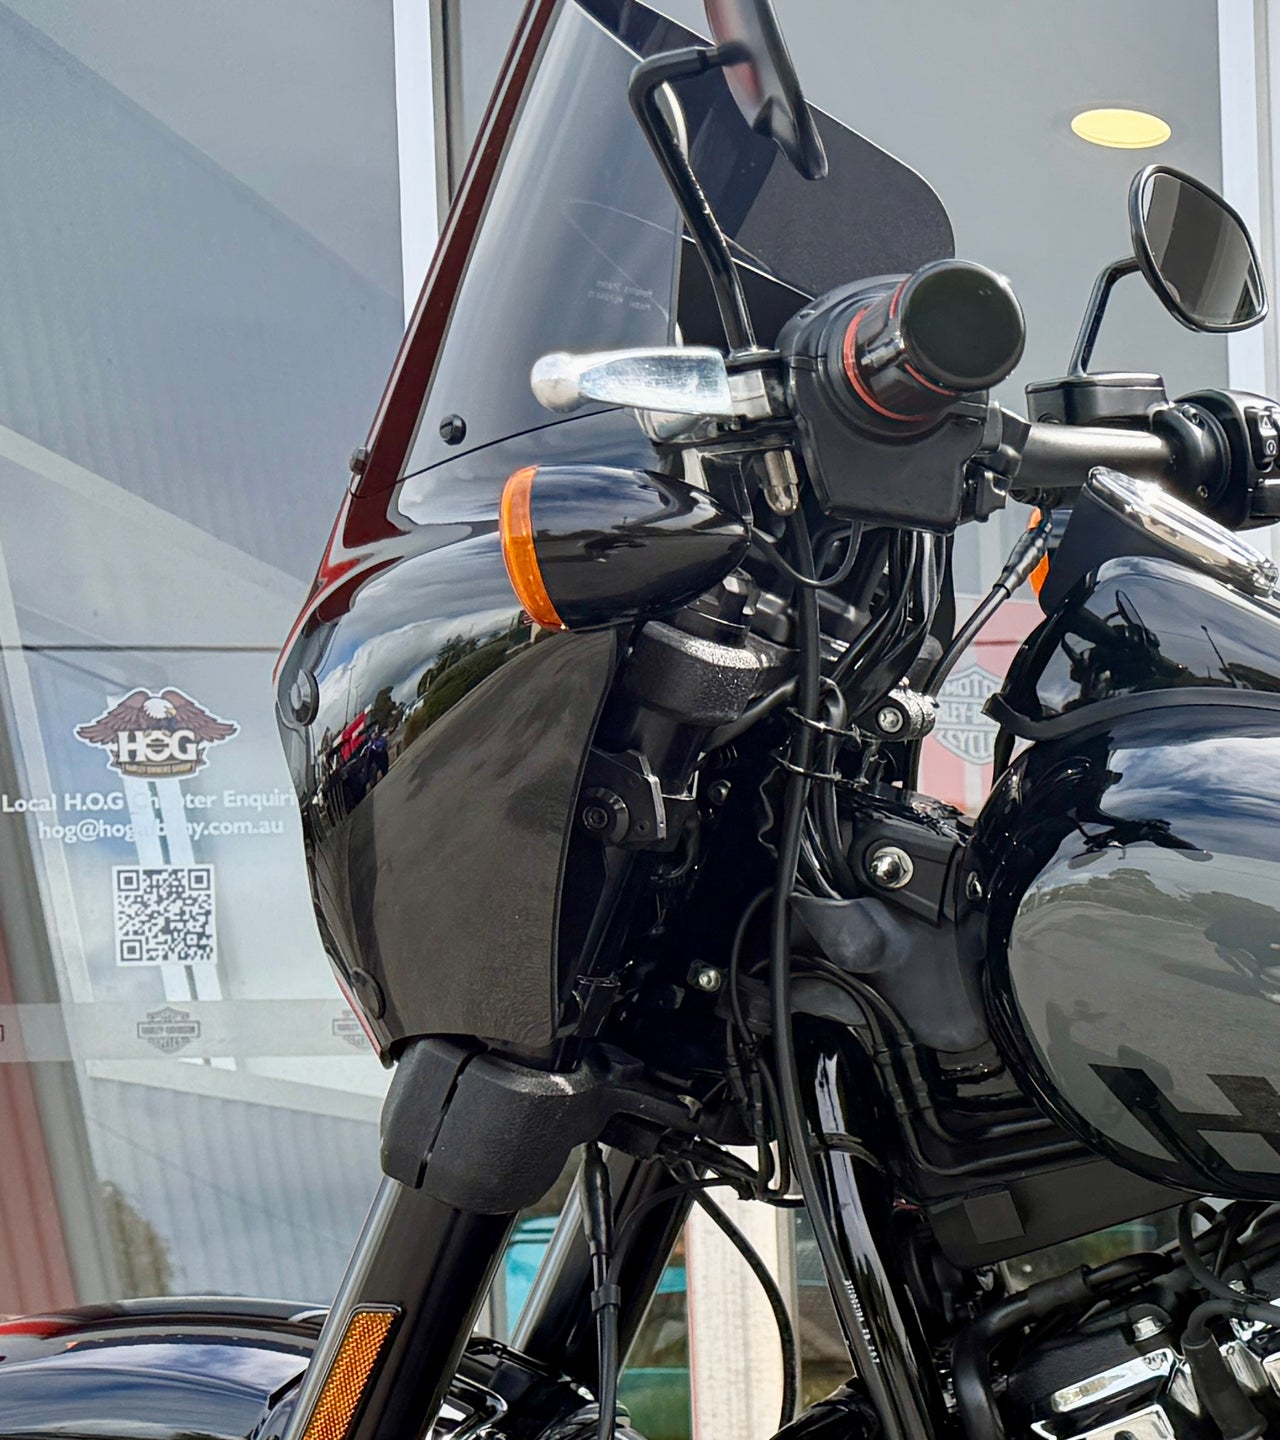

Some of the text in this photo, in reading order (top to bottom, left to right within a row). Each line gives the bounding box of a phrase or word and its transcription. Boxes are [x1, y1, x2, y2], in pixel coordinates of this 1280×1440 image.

[117, 729, 198, 763] HOG
[2, 794, 57, 813] Local
[64, 792, 124, 811] H.O.G
